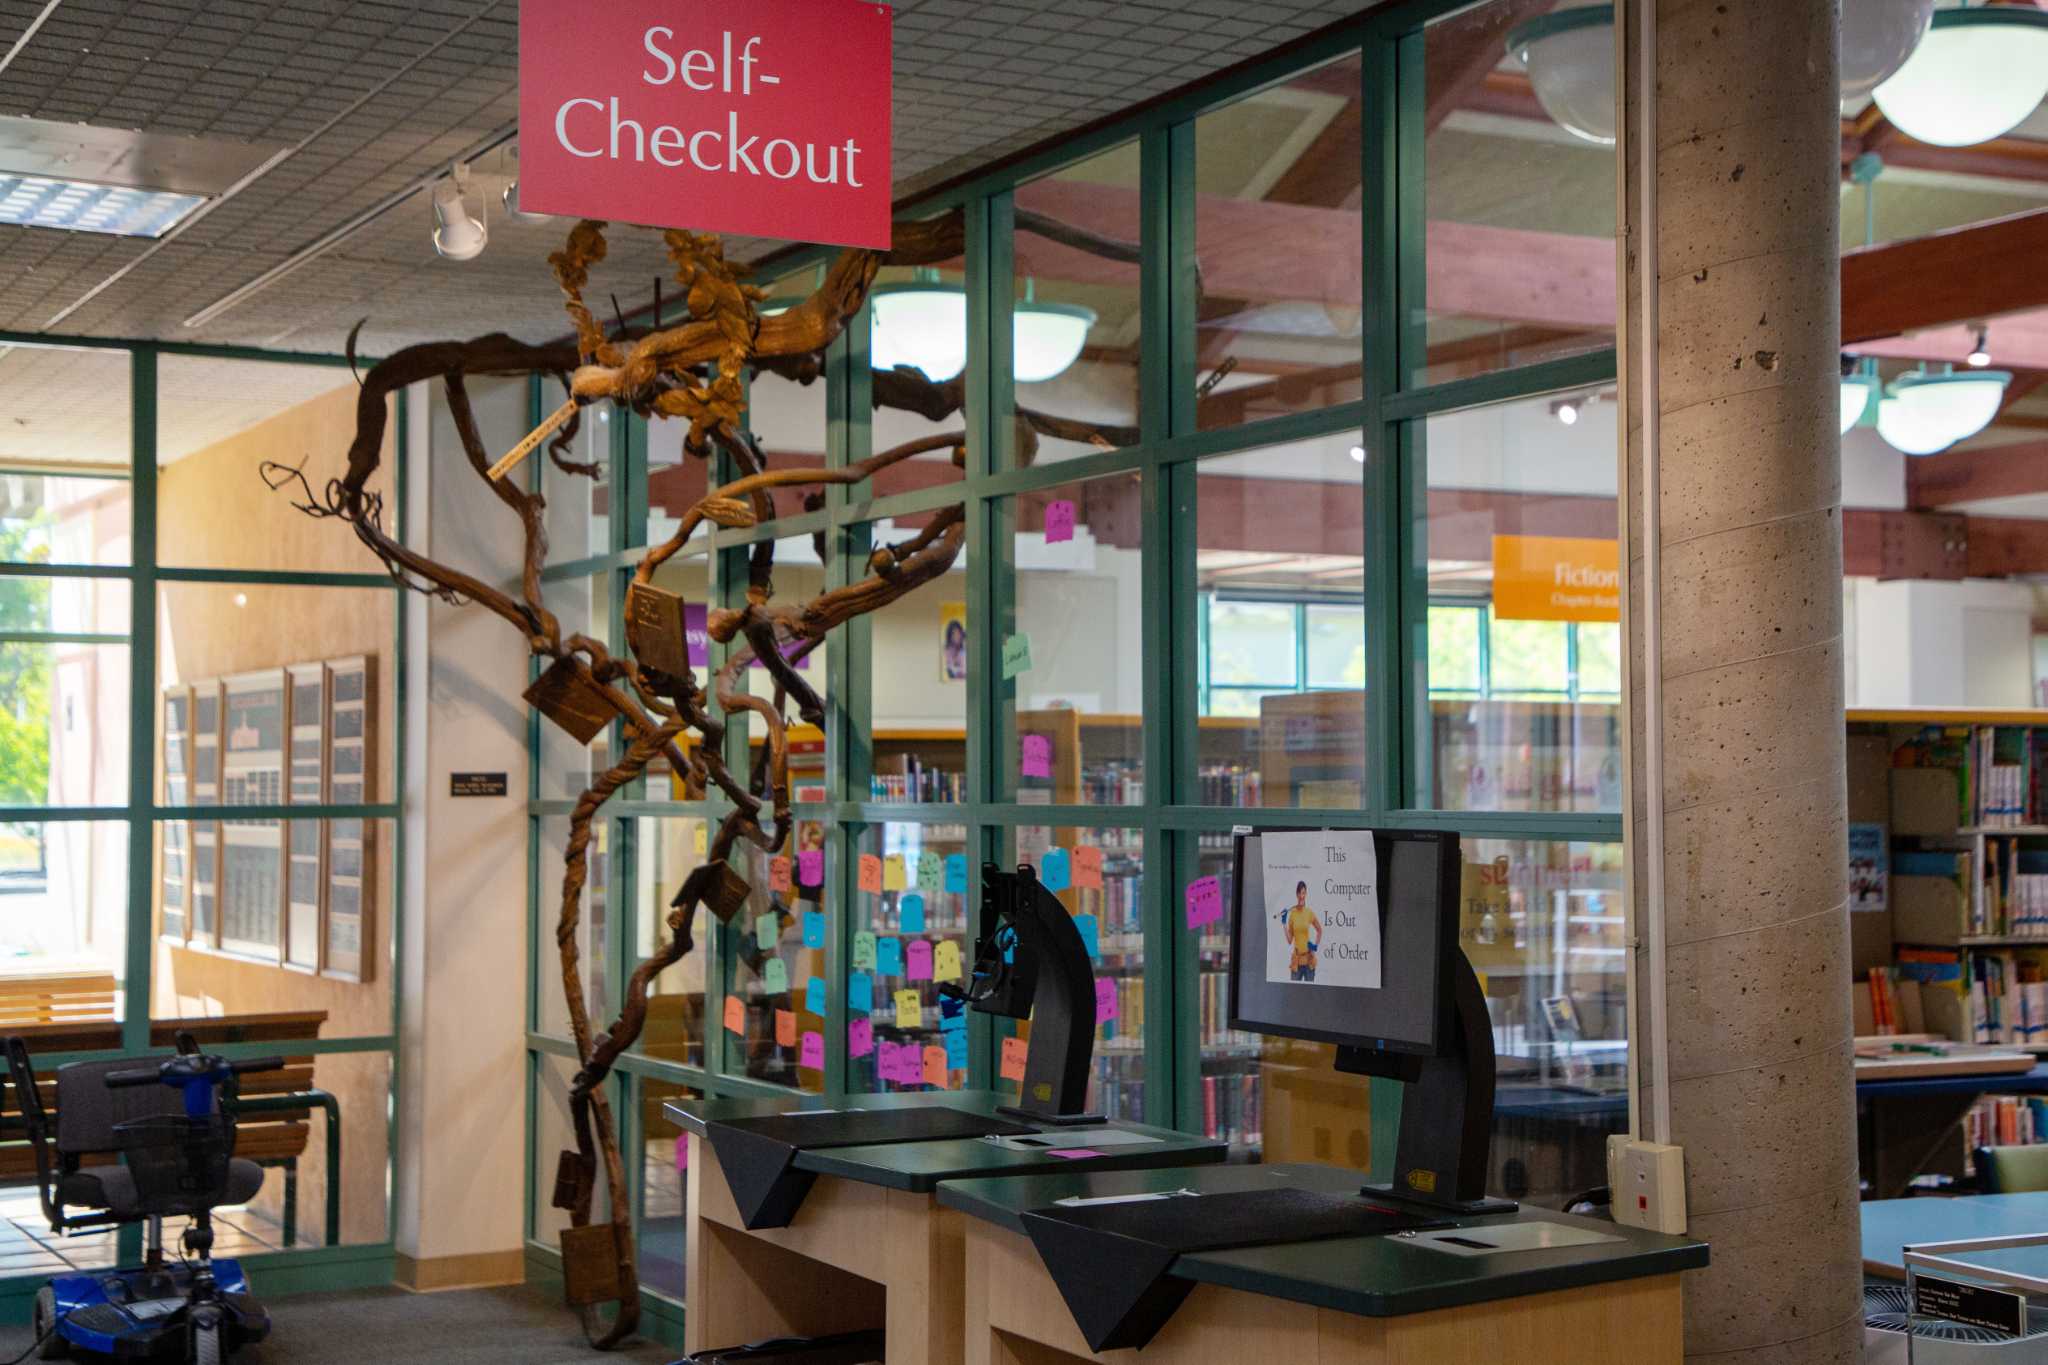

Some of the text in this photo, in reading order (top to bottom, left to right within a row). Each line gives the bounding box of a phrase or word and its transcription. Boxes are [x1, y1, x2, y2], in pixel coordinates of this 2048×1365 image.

[643, 26, 780, 95] Self-
[555, 96, 863, 187] Checkout
[1554, 562, 1619, 588] Fiction
[1324, 846, 1346, 863] This
[1324, 879, 1371, 900] Computer
[1324, 911, 1356, 928] Is Out
[1324, 943, 1369, 961] of Order
